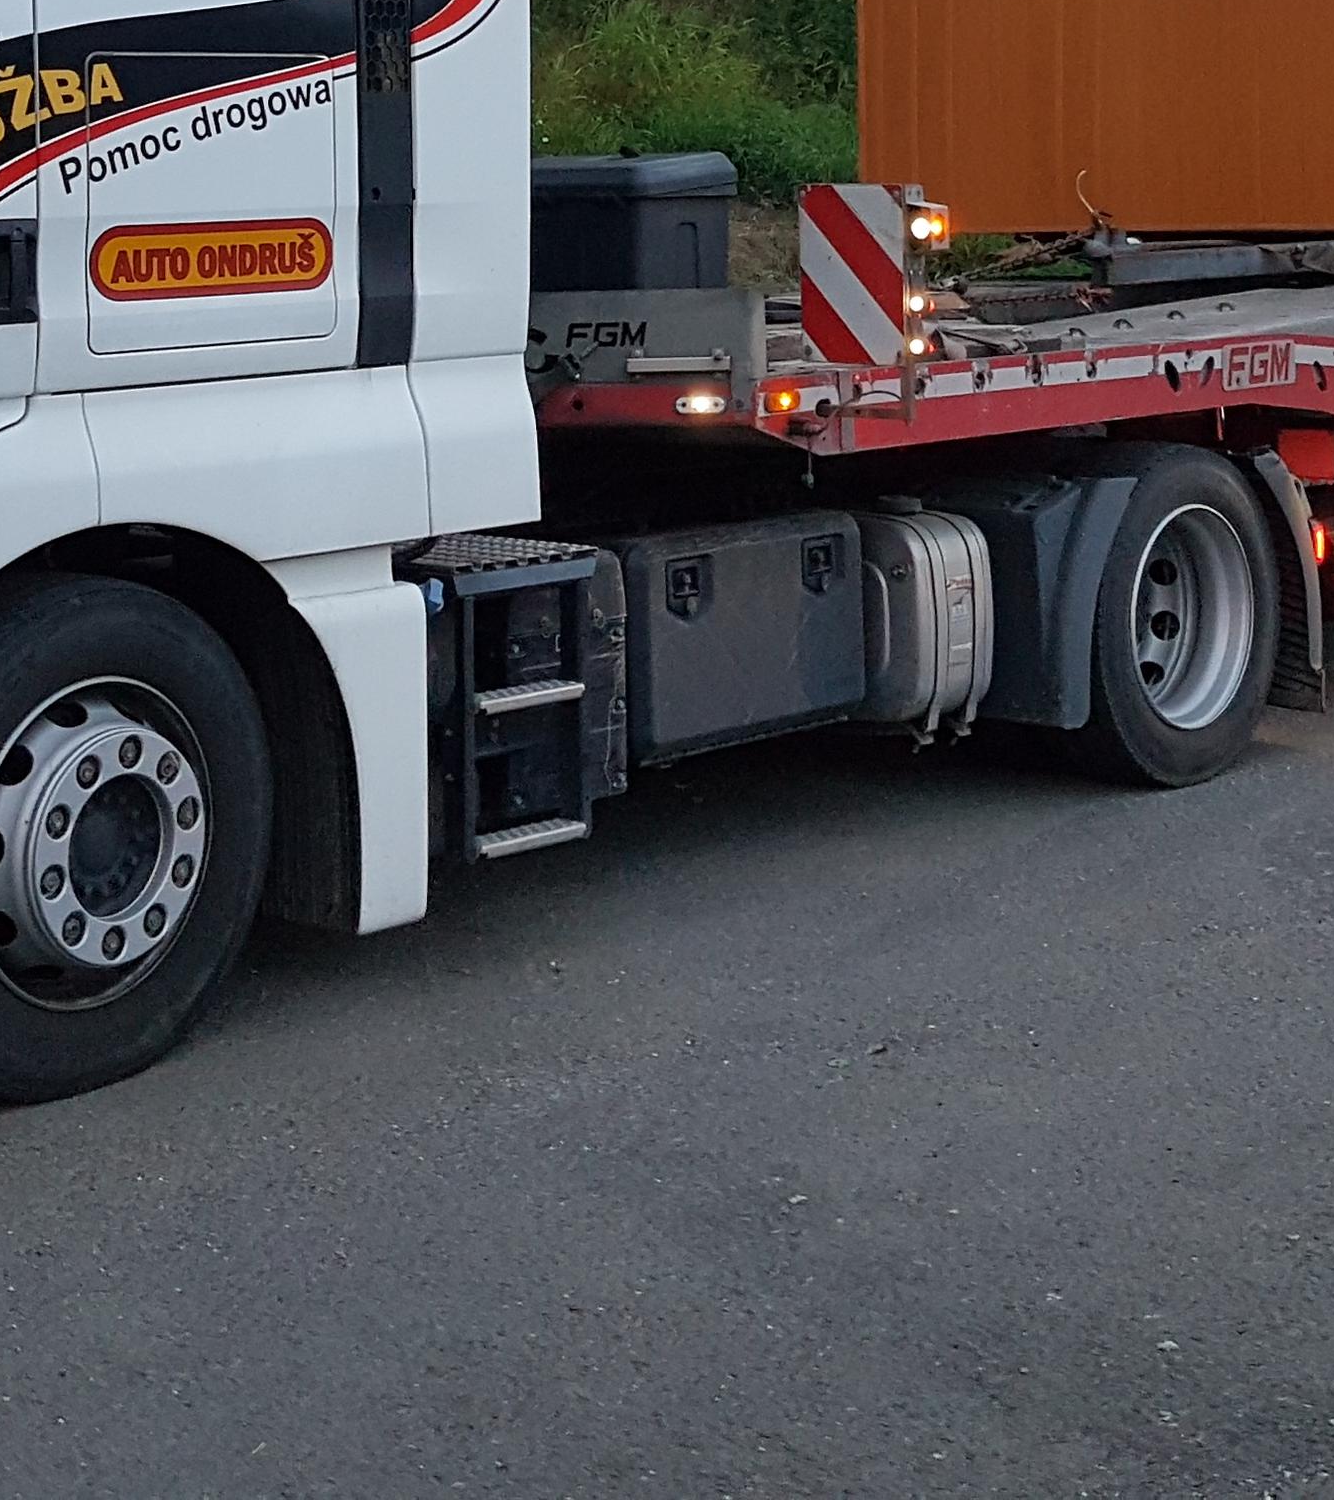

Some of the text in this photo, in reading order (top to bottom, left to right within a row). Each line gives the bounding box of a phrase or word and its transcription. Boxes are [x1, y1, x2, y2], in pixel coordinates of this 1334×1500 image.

[59, 78, 332, 194] Pomoc drogowa
[110, 233, 316, 284] AUTO ONDRUŠ
[567, 321, 646, 349] FGM
[1228, 343, 1291, 386] FGM
